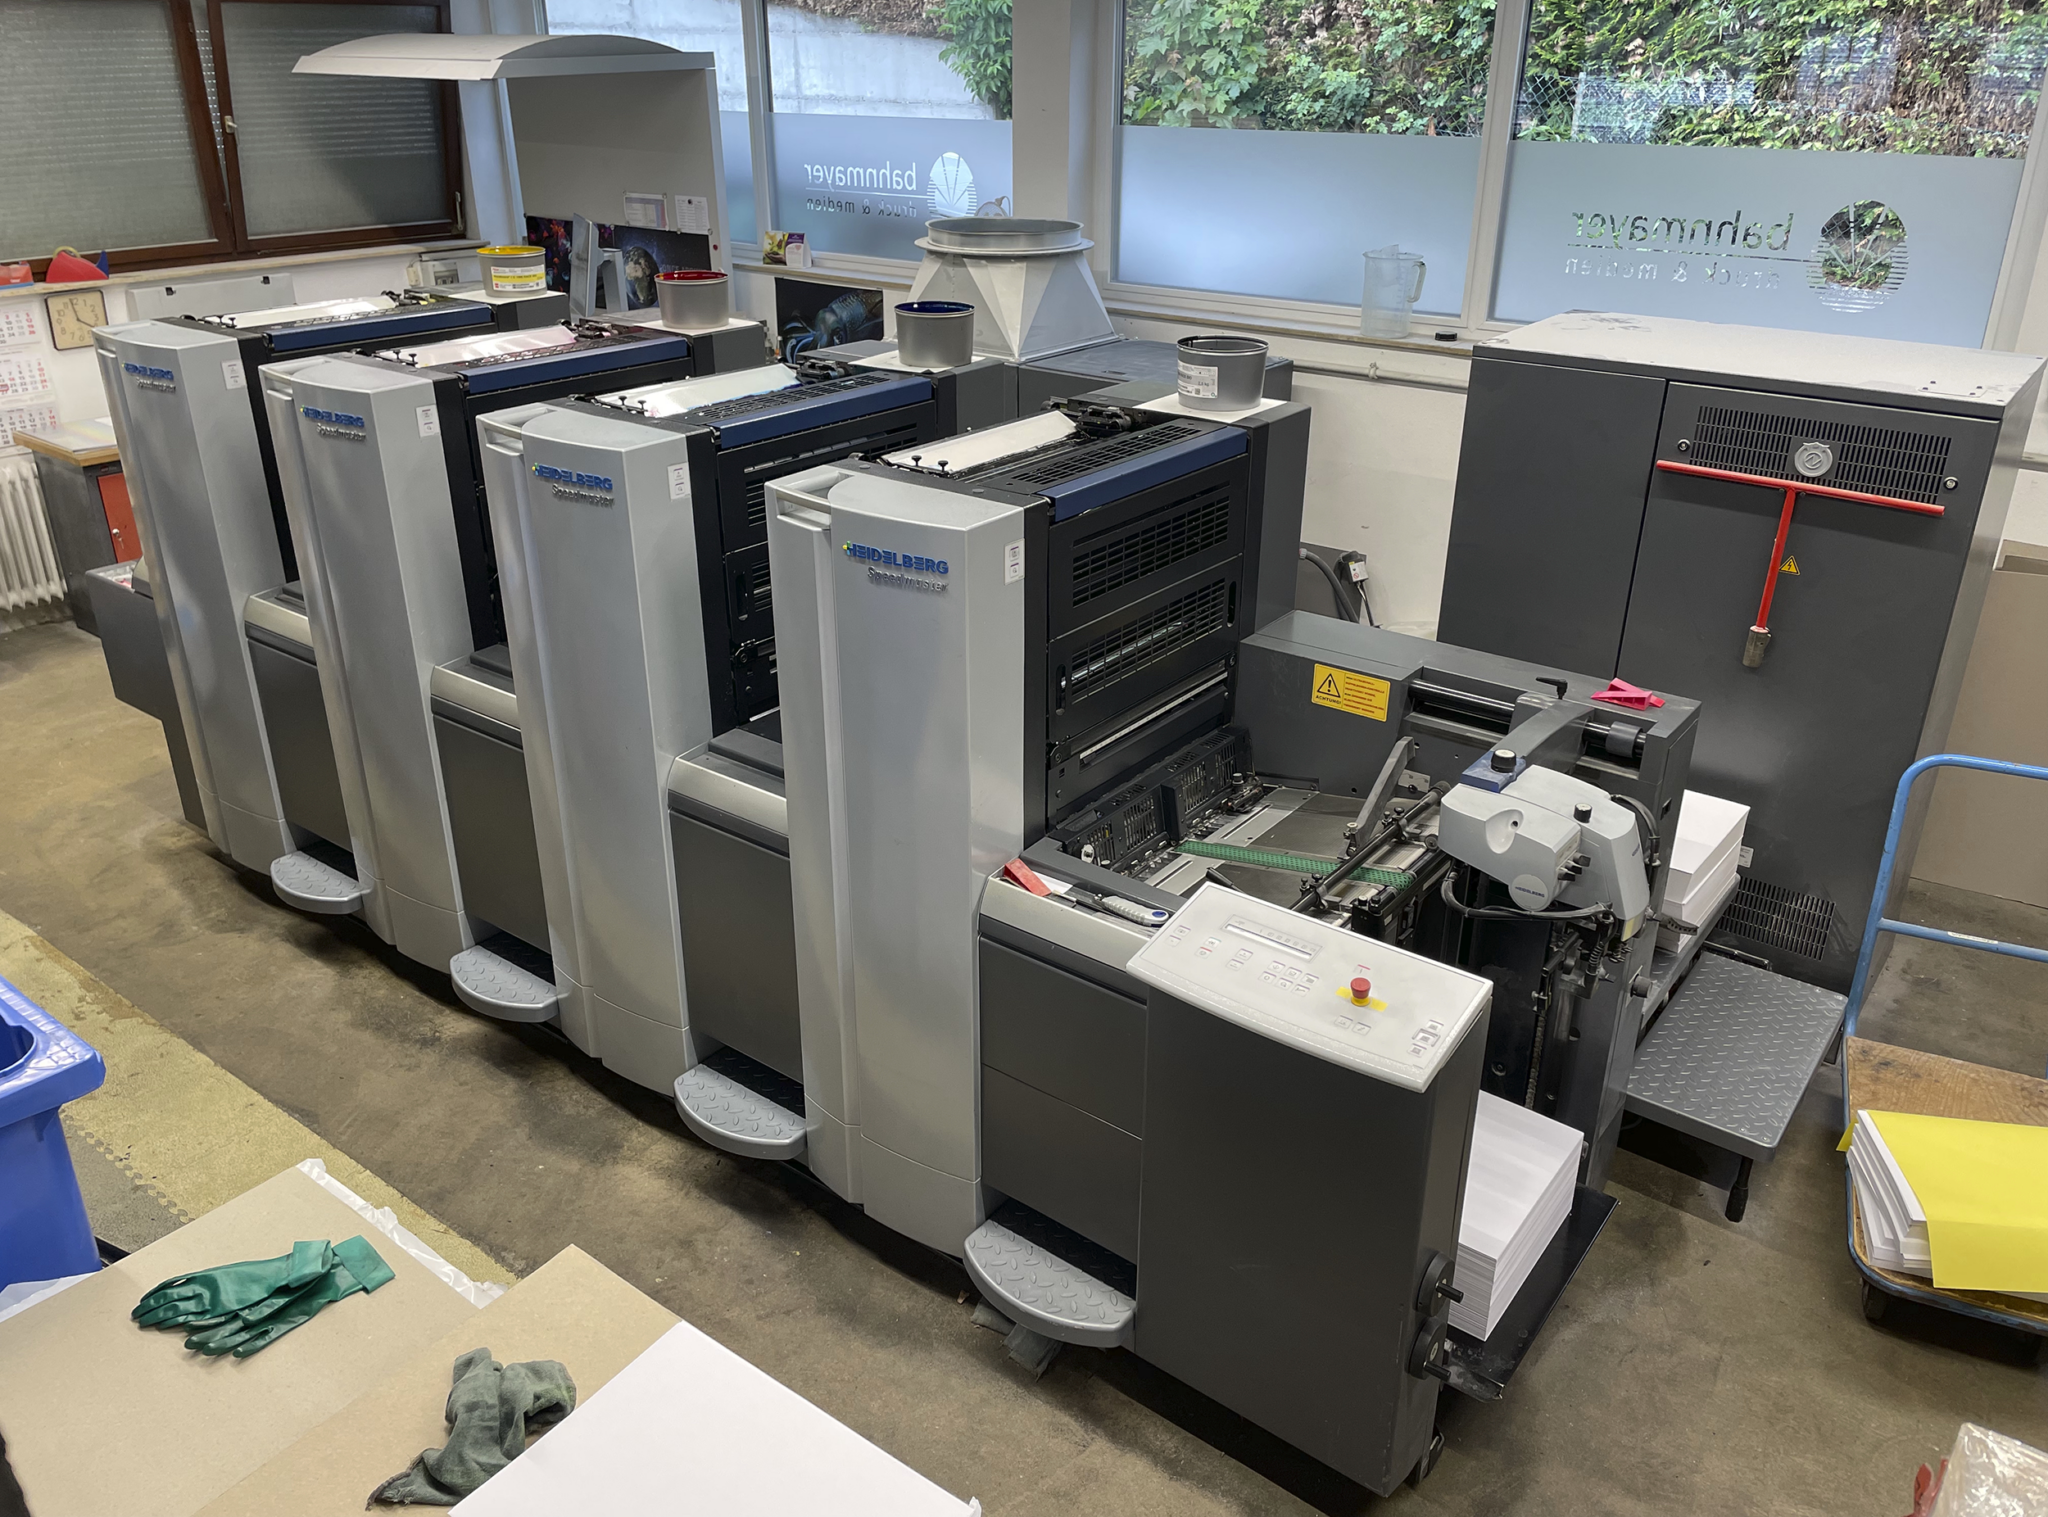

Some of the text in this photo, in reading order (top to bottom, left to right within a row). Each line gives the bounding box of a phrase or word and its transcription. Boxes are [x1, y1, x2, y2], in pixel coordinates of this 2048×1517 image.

[532, 461, 614, 491] HEIDELBERG
[552, 483, 614, 506] Speedmaster
[843, 540, 949, 575] HEIDELBERG
[867, 565, 949, 593] Speedmaster
